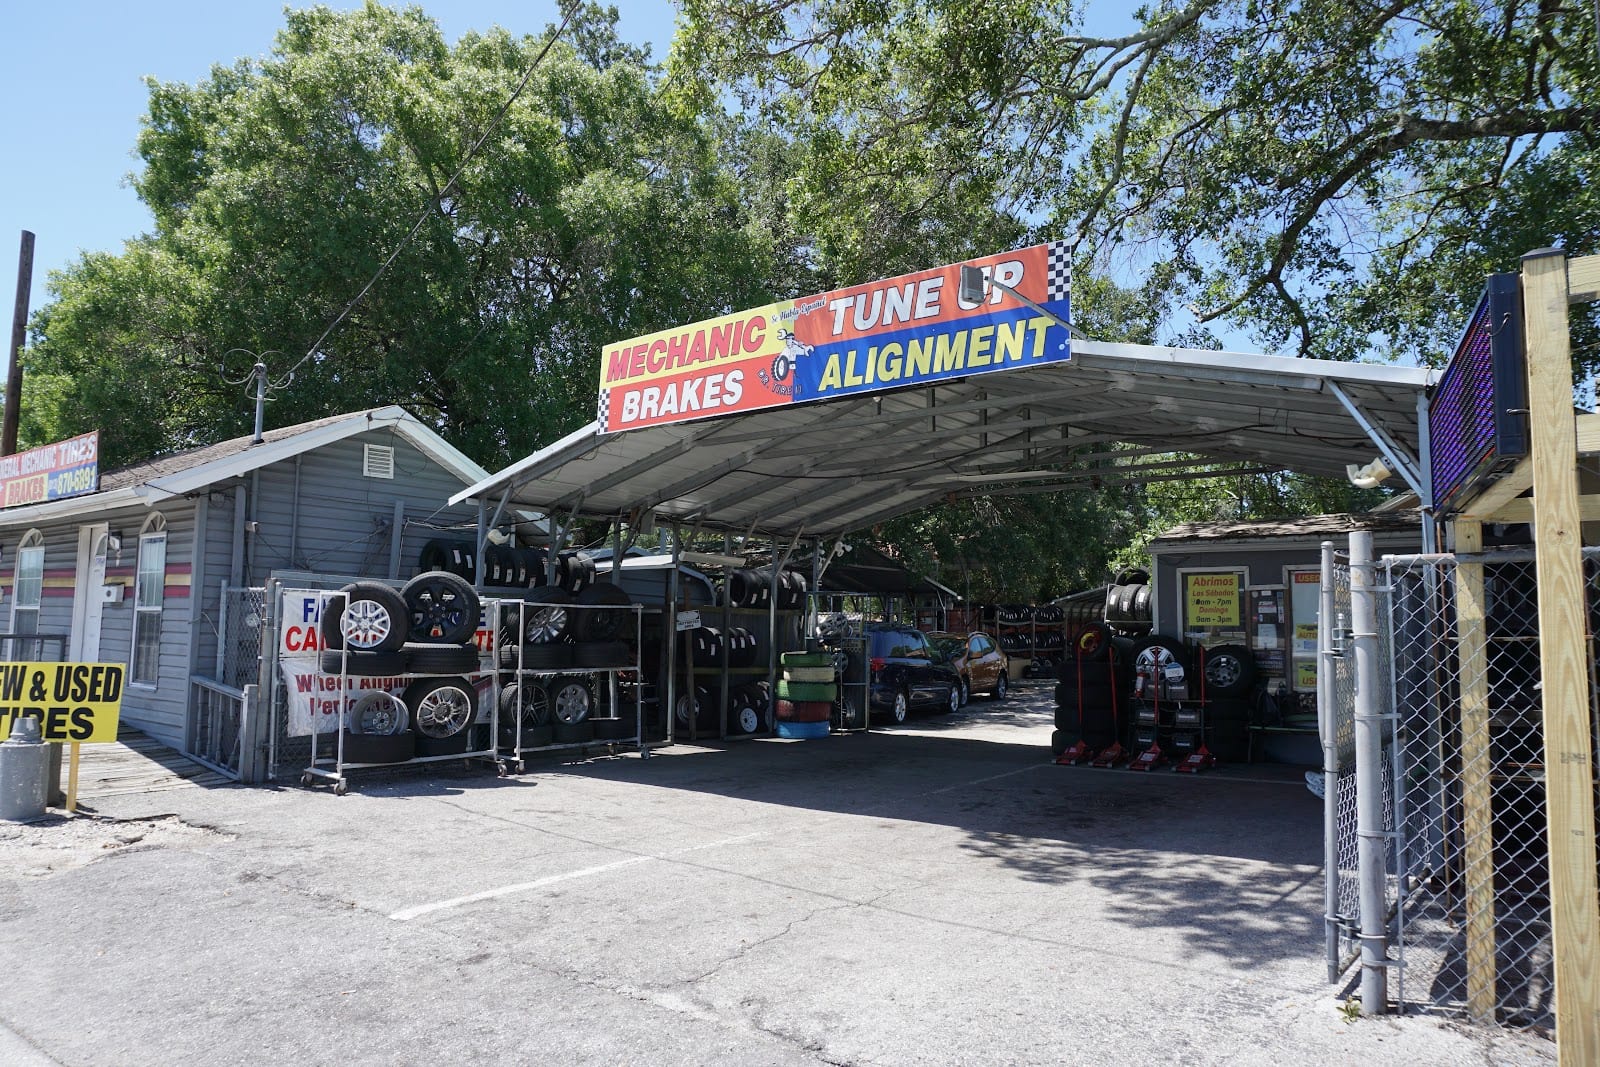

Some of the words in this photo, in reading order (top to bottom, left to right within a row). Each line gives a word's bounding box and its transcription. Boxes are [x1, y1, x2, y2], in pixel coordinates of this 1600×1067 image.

[828, 275, 944, 337] TUNE
[958, 259, 1025, 311] UP
[605, 315, 767, 383] MECHANIC
[817, 315, 1056, 392] ALIGNMENT
[621, 368, 745, 424] BRAKES
[21, 446, 57, 475] MECHANIC
[59, 434, 96, 466] TIRES
[7, 476, 45, 505] BRAKES
[57, 465, 96, 495] 870-6891
[1193, 577, 1233, 586] Abrimos
[1217, 598, 1231, 606] 7pm
[1196, 615, 1211, 623] 9am
[1217, 615, 1232, 624] 3pm
[0, 665, 27, 702] W
[29, 670, 47, 702] &
[53, 665, 123, 703] USED
[1302, 676, 1317, 685] US
